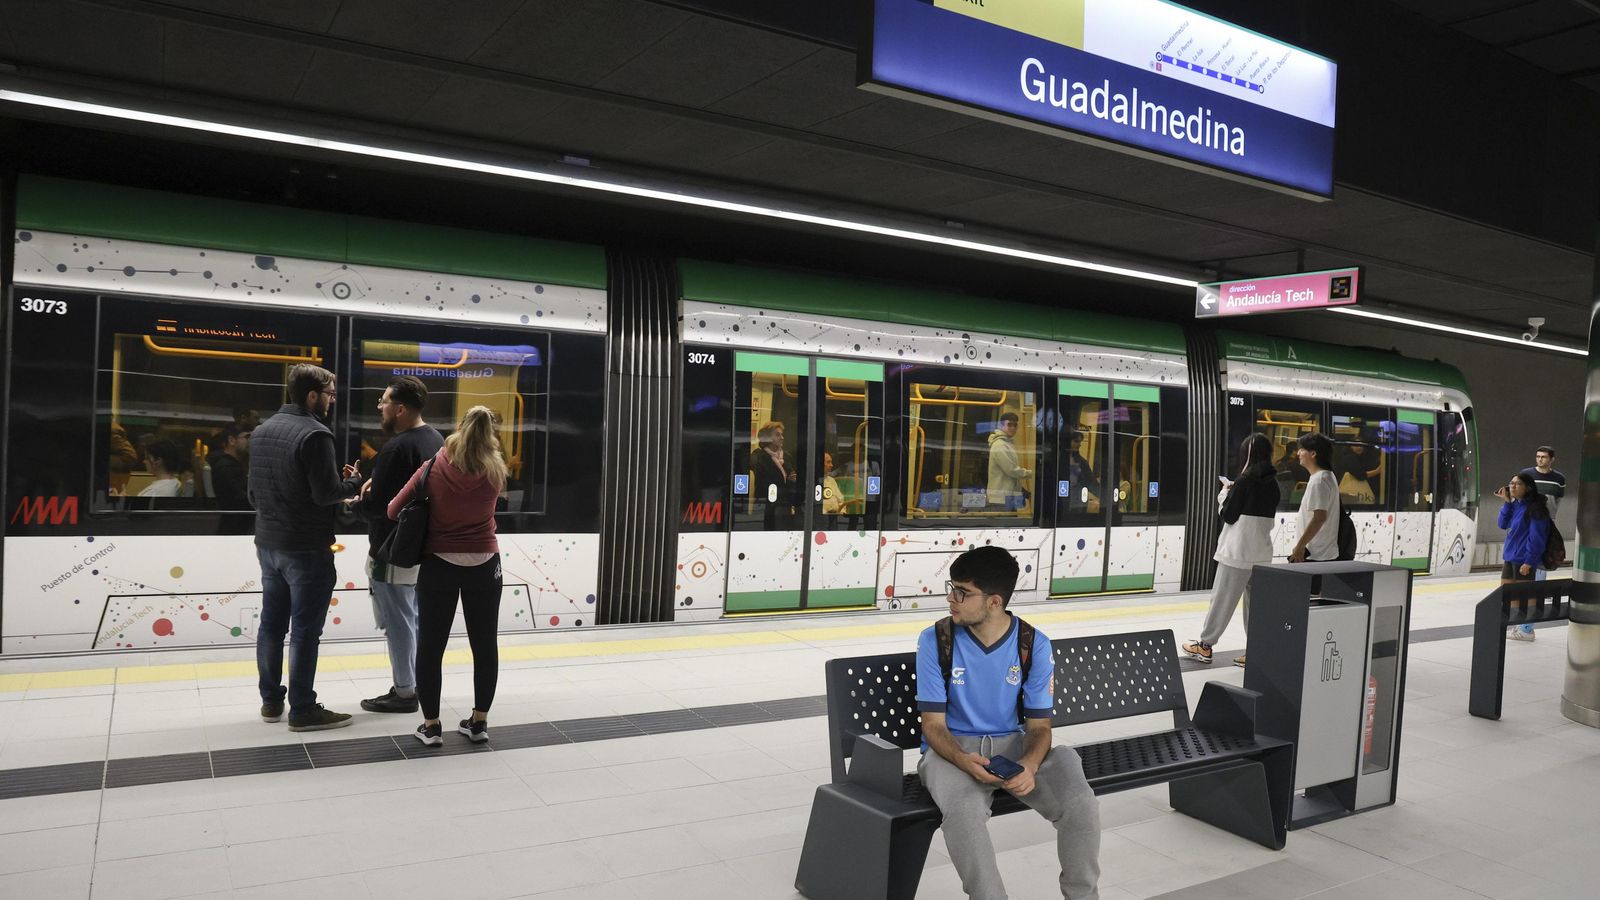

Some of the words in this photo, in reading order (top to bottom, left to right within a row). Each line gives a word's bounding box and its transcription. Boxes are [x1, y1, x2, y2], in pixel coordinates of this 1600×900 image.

[1020, 57, 1245, 156] Guadalmedina
[20, 297, 68, 315] 3073
[1227, 290, 1281, 308] Andalucía
[1285, 288, 1314, 303] Tech
[688, 352, 715, 365] 3074
[1230, 396, 1244, 406] 3075
[40, 571, 72, 592] Puesto
[71, 563, 84, 574] de
[83, 542, 117, 566] Control
